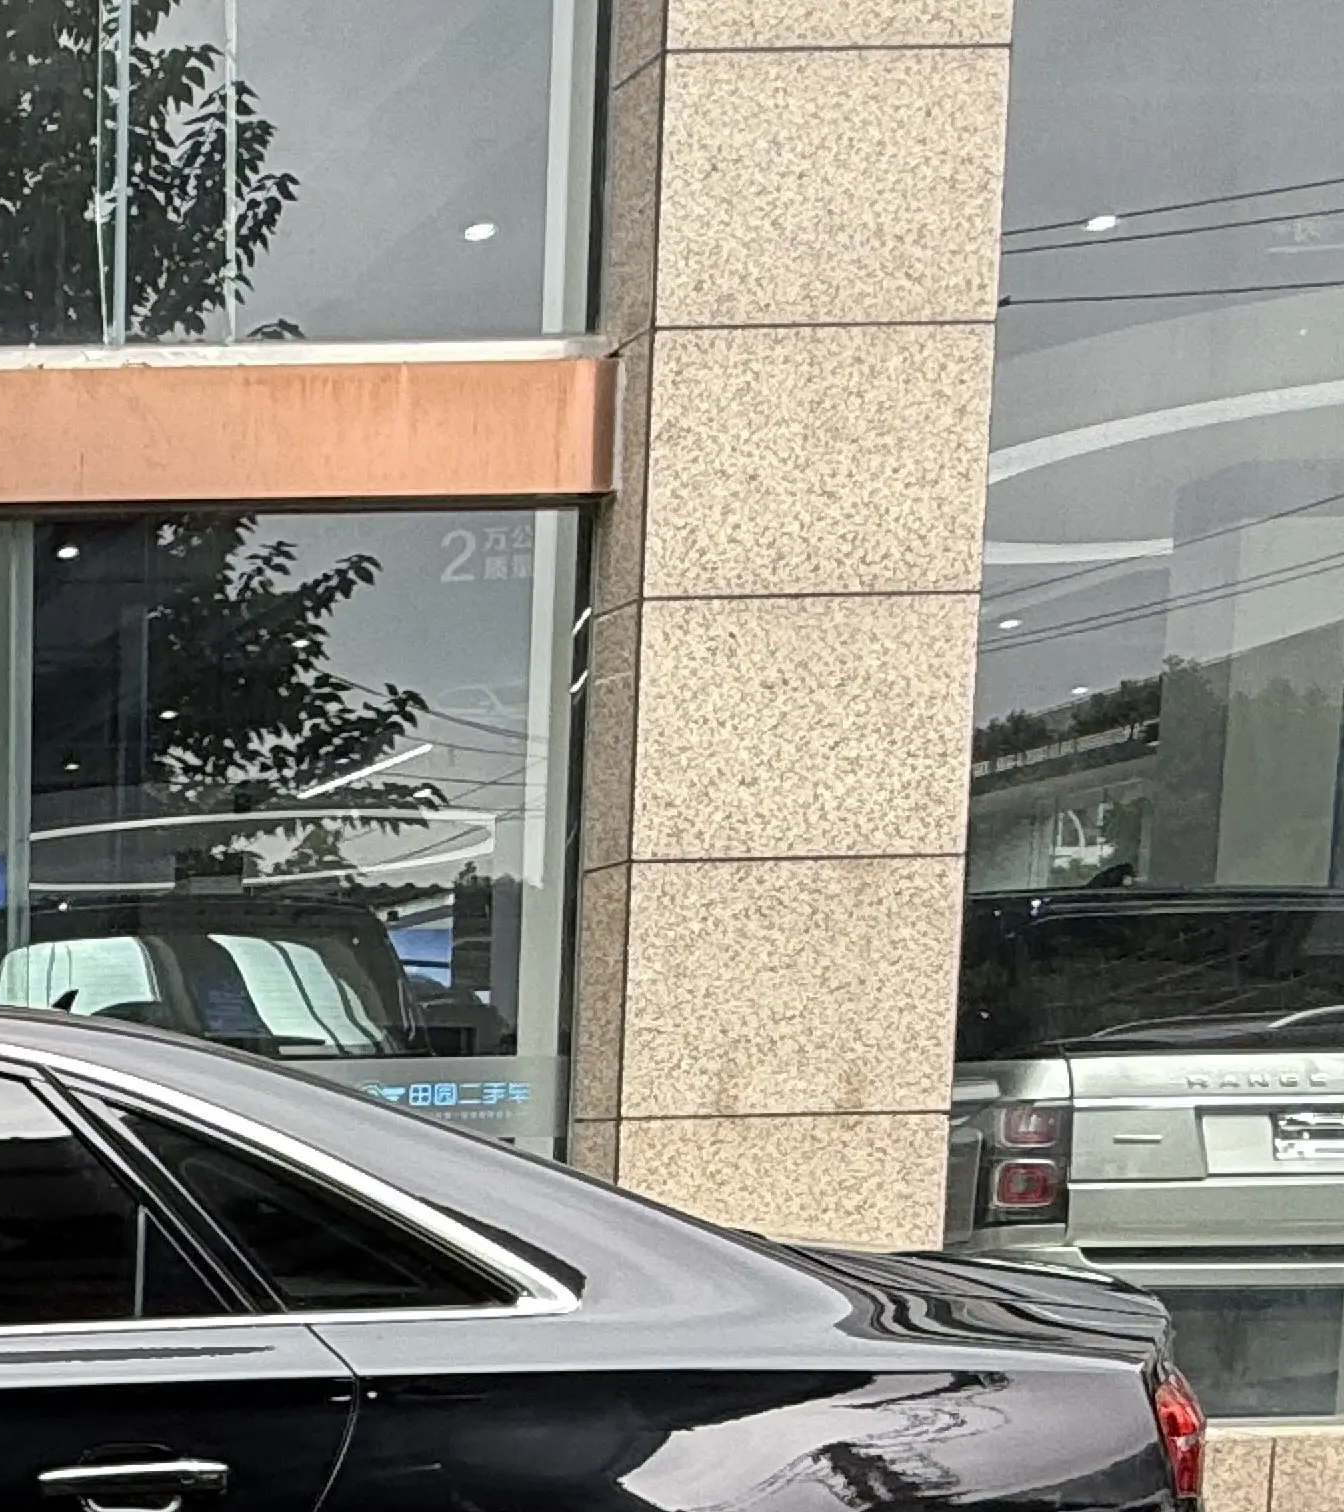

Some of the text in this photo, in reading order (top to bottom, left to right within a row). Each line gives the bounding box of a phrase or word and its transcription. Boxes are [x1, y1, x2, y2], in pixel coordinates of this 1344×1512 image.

[1184, 1070, 1330, 1089] RANGE
[408, 1082, 532, 1107] 田园二手车
